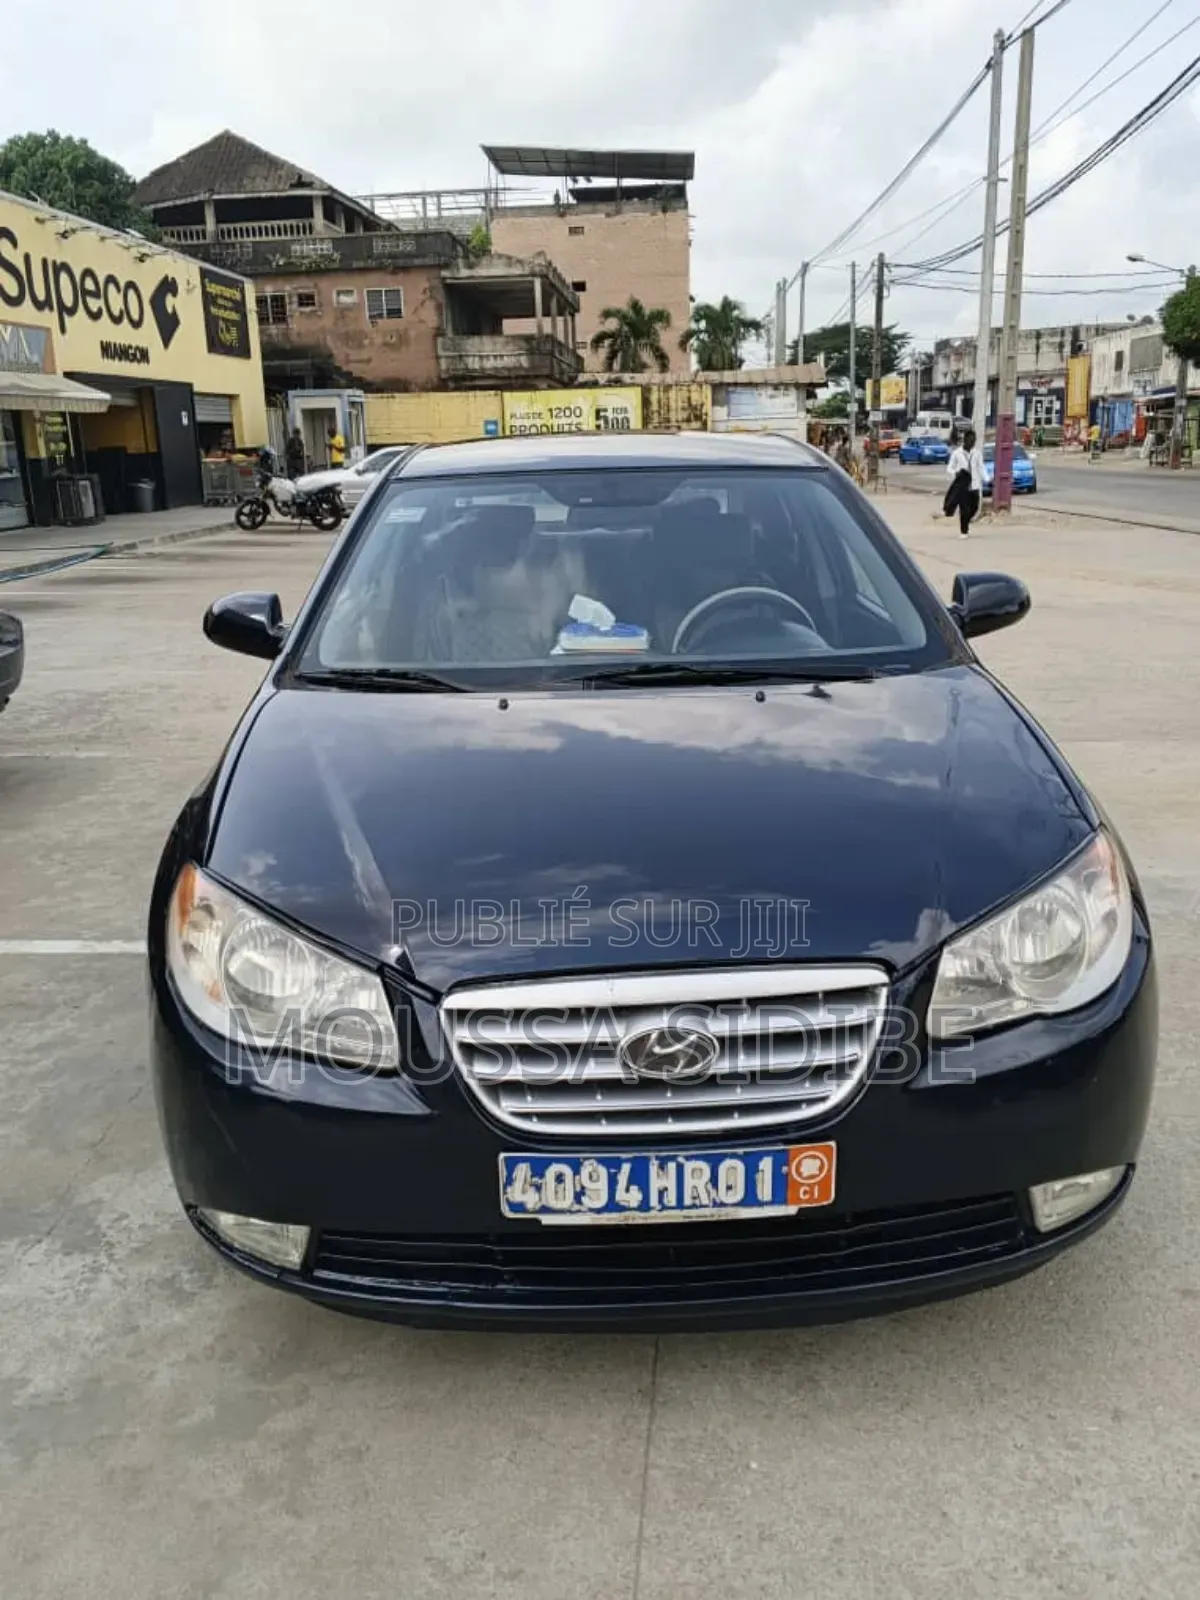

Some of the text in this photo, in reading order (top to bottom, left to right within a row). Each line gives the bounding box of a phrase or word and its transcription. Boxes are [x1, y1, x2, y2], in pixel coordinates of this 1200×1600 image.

[0, 226, 144, 335] Supeco
[100, 340, 150, 365] NIANGON
[548, 406, 583, 419] 1200
[509, 422, 584, 435] PRODUITS
[799, 1185, 819, 1200] CI
